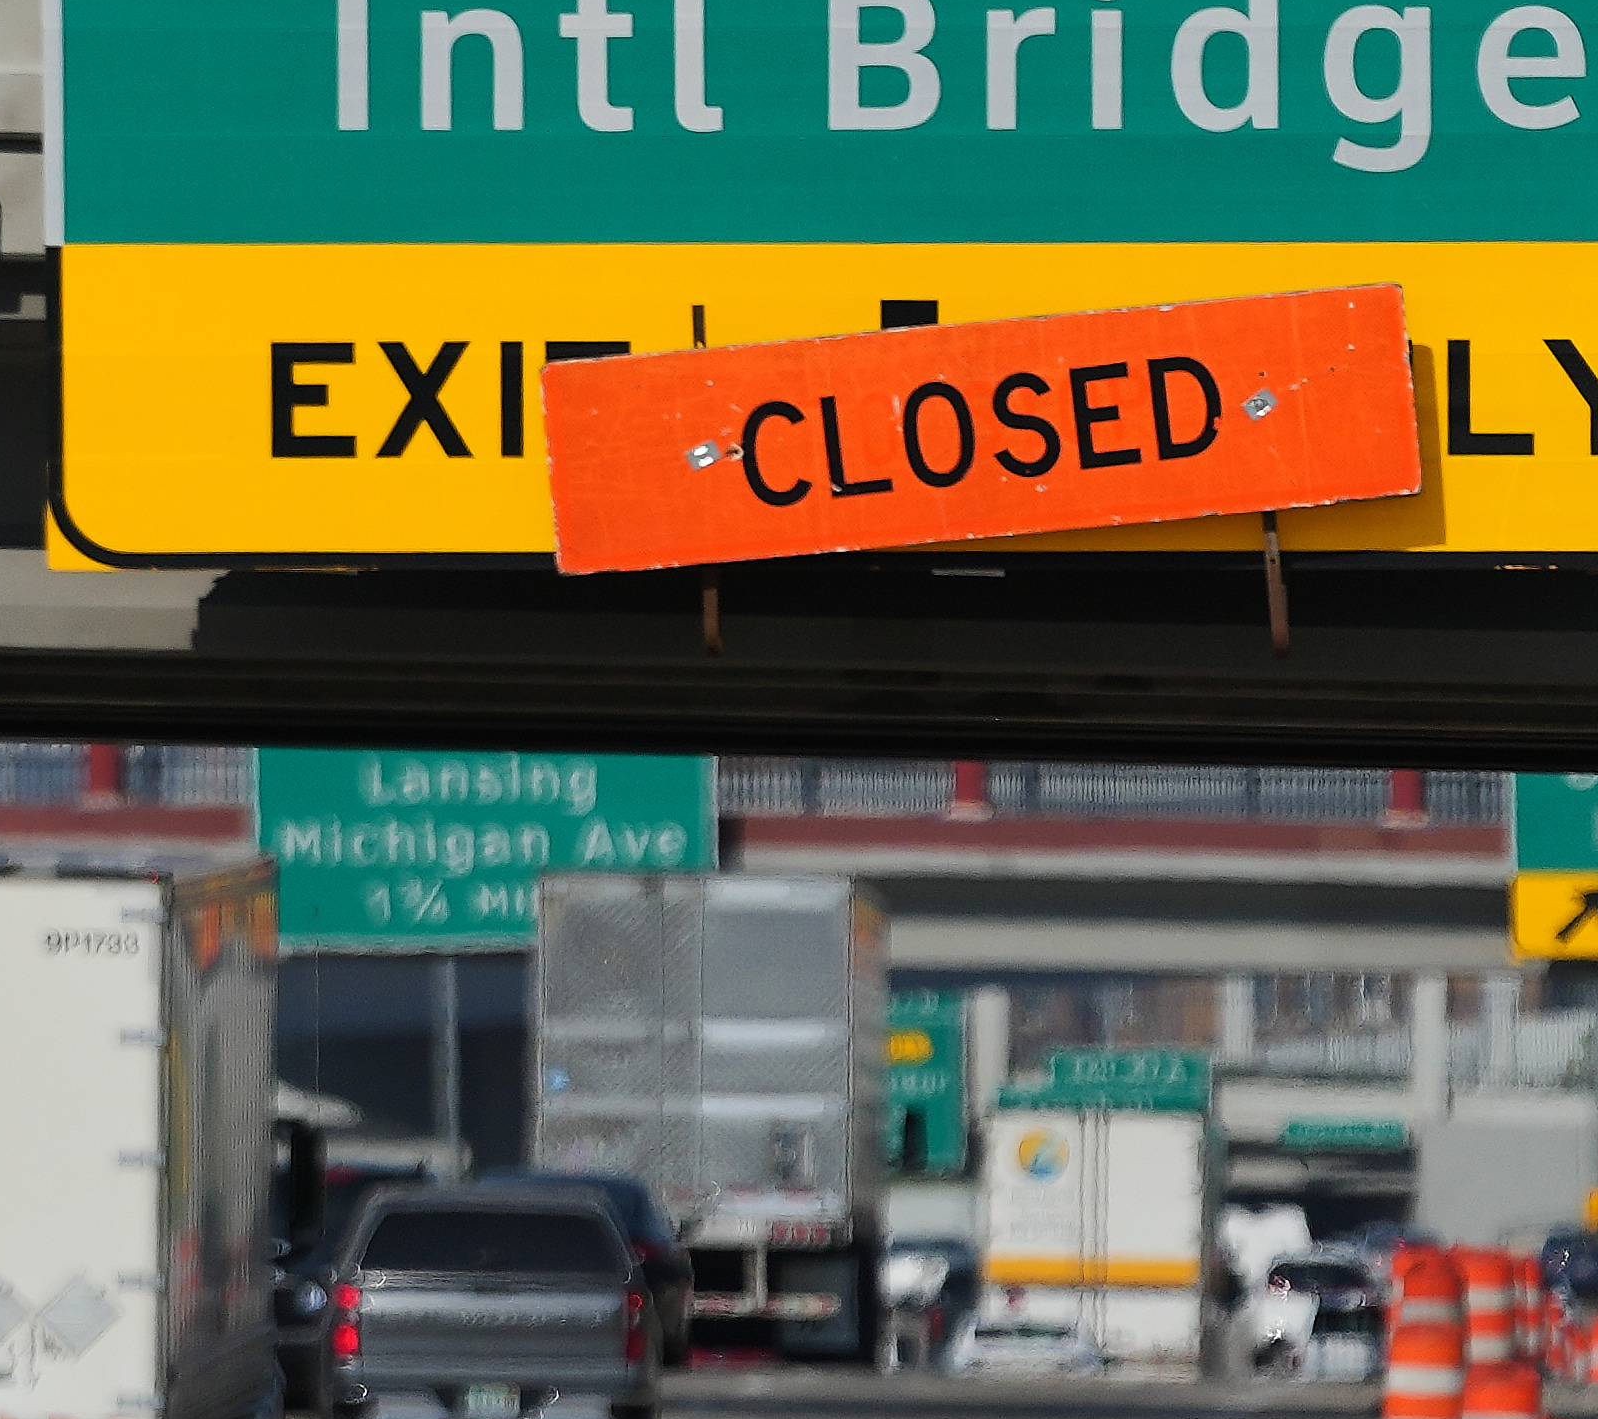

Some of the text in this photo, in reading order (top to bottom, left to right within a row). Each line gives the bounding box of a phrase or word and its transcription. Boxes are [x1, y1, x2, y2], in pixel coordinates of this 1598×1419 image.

[269, 339, 632, 460] EXI
[740, 354, 1223, 507] CLOSED
[361, 751, 598, 818] Lansing
[279, 816, 687, 877] Michigan Ave
